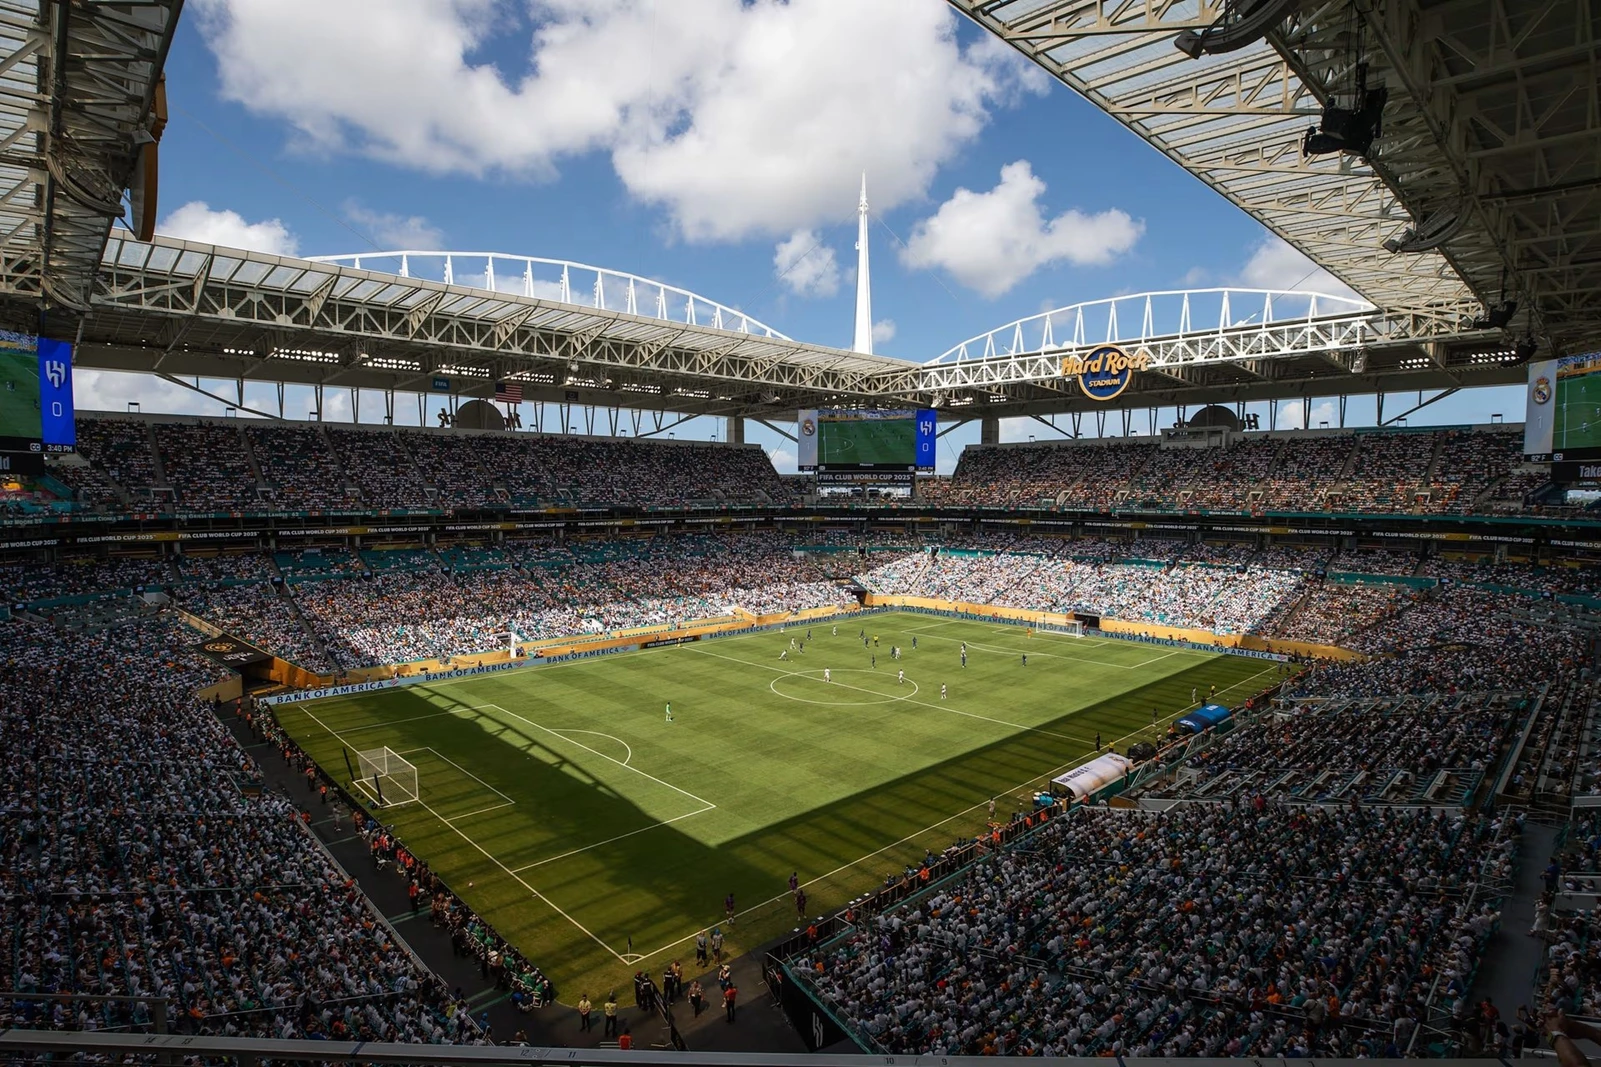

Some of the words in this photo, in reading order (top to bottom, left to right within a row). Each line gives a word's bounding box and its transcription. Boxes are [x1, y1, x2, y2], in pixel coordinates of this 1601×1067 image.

[1060, 353, 1104, 376] Hard
[1104, 350, 1149, 375] Rock
[1088, 378, 1121, 388] STADIUM
[52, 401, 62, 417] 0
[1579, 465, 1601, 478] Take
[808, 616, 830, 624] AMERICA
[923, 608, 950, 617] AMERICA
[960, 613, 977, 621] BANK
[986, 616, 1017, 625] AMERICA
[709, 631, 726, 639] BANK
[735, 625, 763, 635] AMERICA
[1104, 632, 1125, 640] BANK
[1127, 634, 1137, 642] OF
[1139, 635, 1175, 647] AMERICA
[546, 654, 569, 664] BANK
[571, 651, 583, 660] OF
[584, 647, 619, 659] AMERICA
[1191, 643, 1214, 652] BANK
[1217, 646, 1228, 654] OF
[1230, 648, 1273, 660] AMERICA
[425, 671, 453, 681] BANK
[456, 668, 468, 677] OF
[470, 662, 513, 674] AMERICA
[277, 690, 310, 704] BANK
[314, 688, 329, 698] OF
[332, 681, 384, 694] AMERICA
